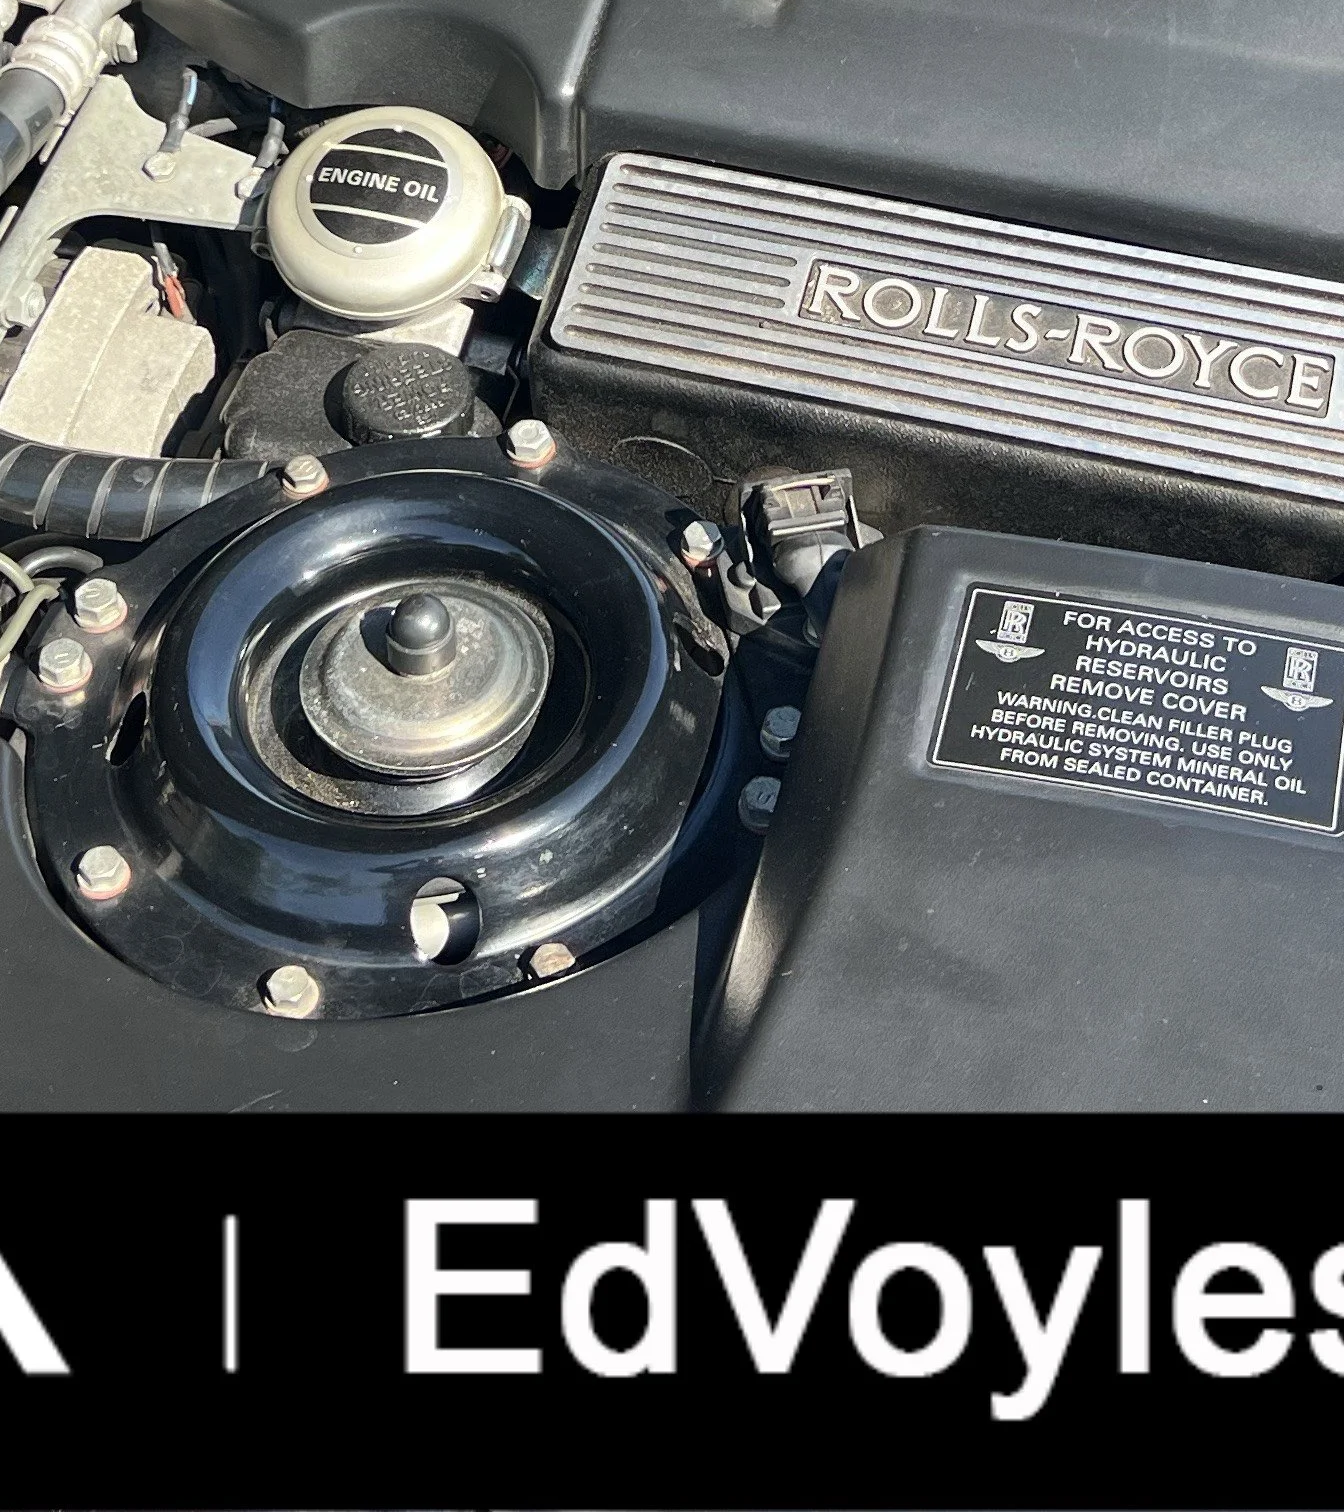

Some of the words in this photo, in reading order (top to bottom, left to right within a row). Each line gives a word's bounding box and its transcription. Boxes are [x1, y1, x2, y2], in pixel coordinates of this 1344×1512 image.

[318, 166, 401, 193] ENGINE
[403, 180, 439, 204] OIL
[809, 262, 1332, 411] ROLLS-ROYCE
[1063, 610, 1112, 632] FOR
[1117, 619, 1215, 648] ACCESS
[1222, 636, 1257, 656] TO
[1085, 634, 1228, 673] HYDRAULIC
[1050, 674, 1155, 706] REMOVE
[1162, 692, 1248, 722] COVER
[1075, 655, 1229, 695] RESERVOIRS
[970, 724, 1083, 754] HYDRAULIC
[1088, 742, 1172, 769] SYSTEM
[1176, 757, 1268, 787] MINERAL
[1274, 775, 1307, 795] OIL
[991, 708, 1067, 733] BEFORE
[1072, 720, 1184, 753] REMOVING.
[1192, 740, 1232, 762] USE
[1238, 750, 1293, 772] ONLY
[1168, 718, 1233, 743] FILLER
[1238, 731, 1293, 754] PLUG
[1000, 747, 1059, 770] FROM
[1063, 756, 1142, 782] SEALED
[1146, 771, 1269, 806] CONTAINER.
